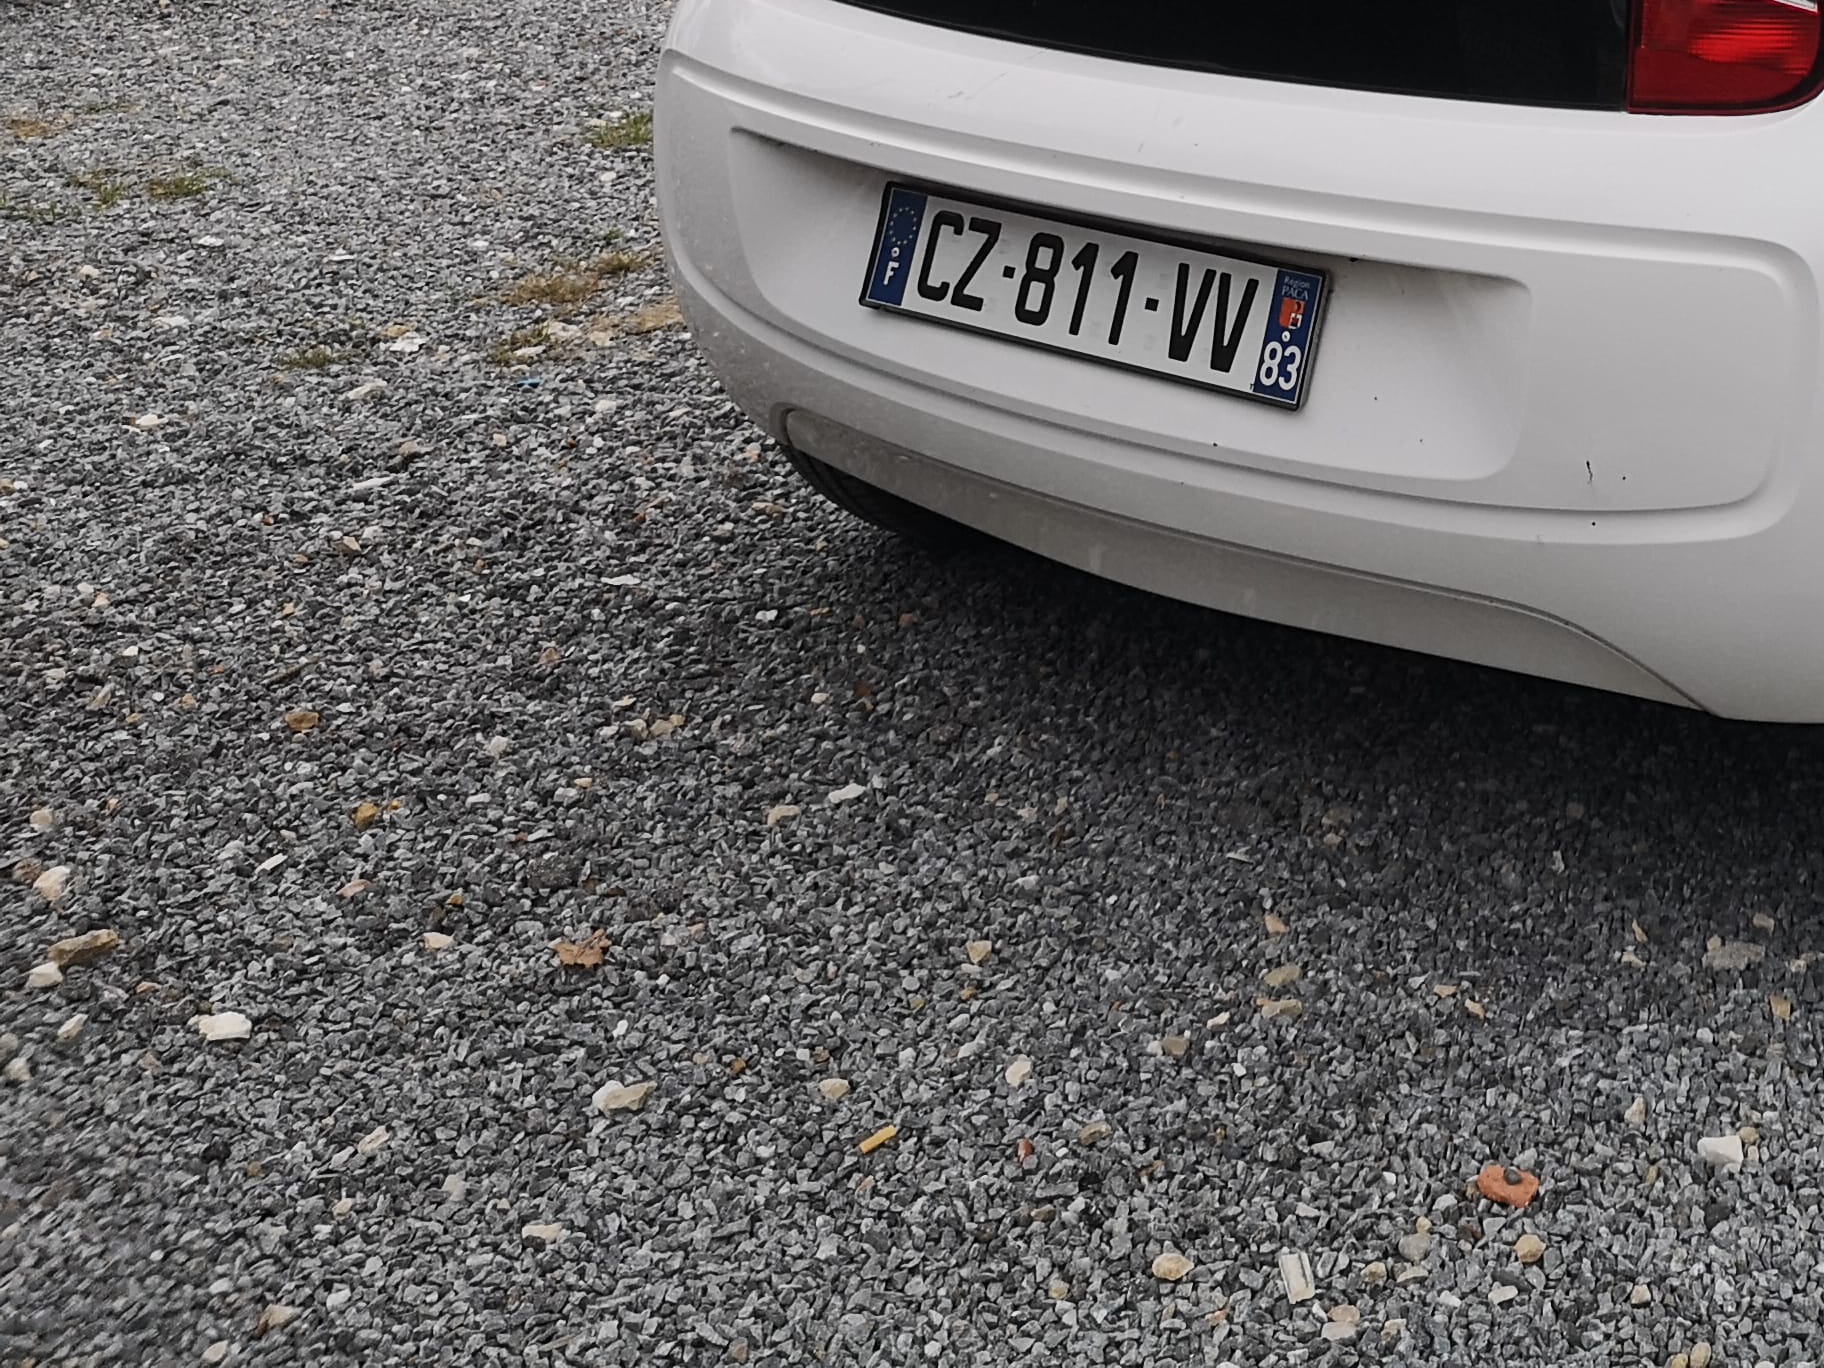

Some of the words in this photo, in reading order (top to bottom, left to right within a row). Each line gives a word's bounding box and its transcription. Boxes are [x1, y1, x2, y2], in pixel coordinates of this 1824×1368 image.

[882, 261, 899, 286] F
[917, 210, 1259, 373] CZ-811-VV
[1281, 285, 1309, 301] PACA
[1259, 340, 1301, 391] 83
